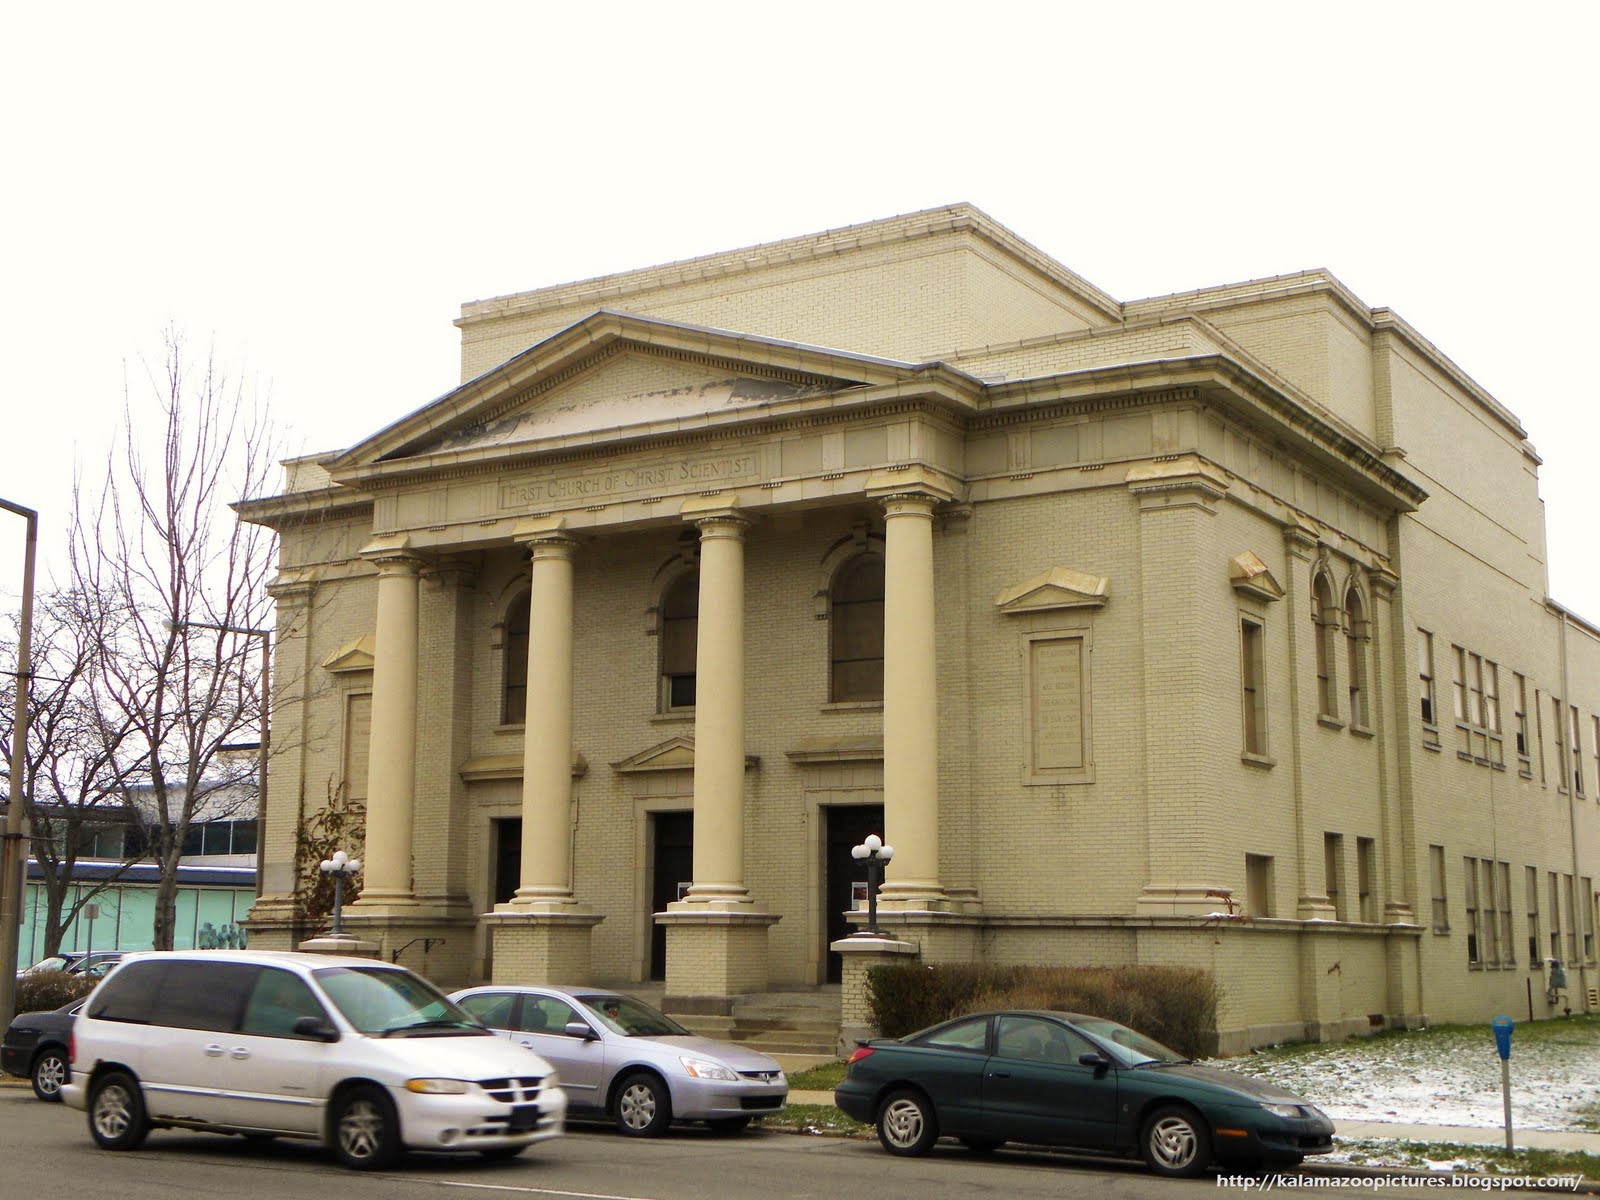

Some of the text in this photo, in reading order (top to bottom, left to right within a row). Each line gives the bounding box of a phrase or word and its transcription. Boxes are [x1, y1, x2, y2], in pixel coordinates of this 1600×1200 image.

[509, 457, 751, 503] FIRST CHURCH OF CHRIST SCIENTIST
